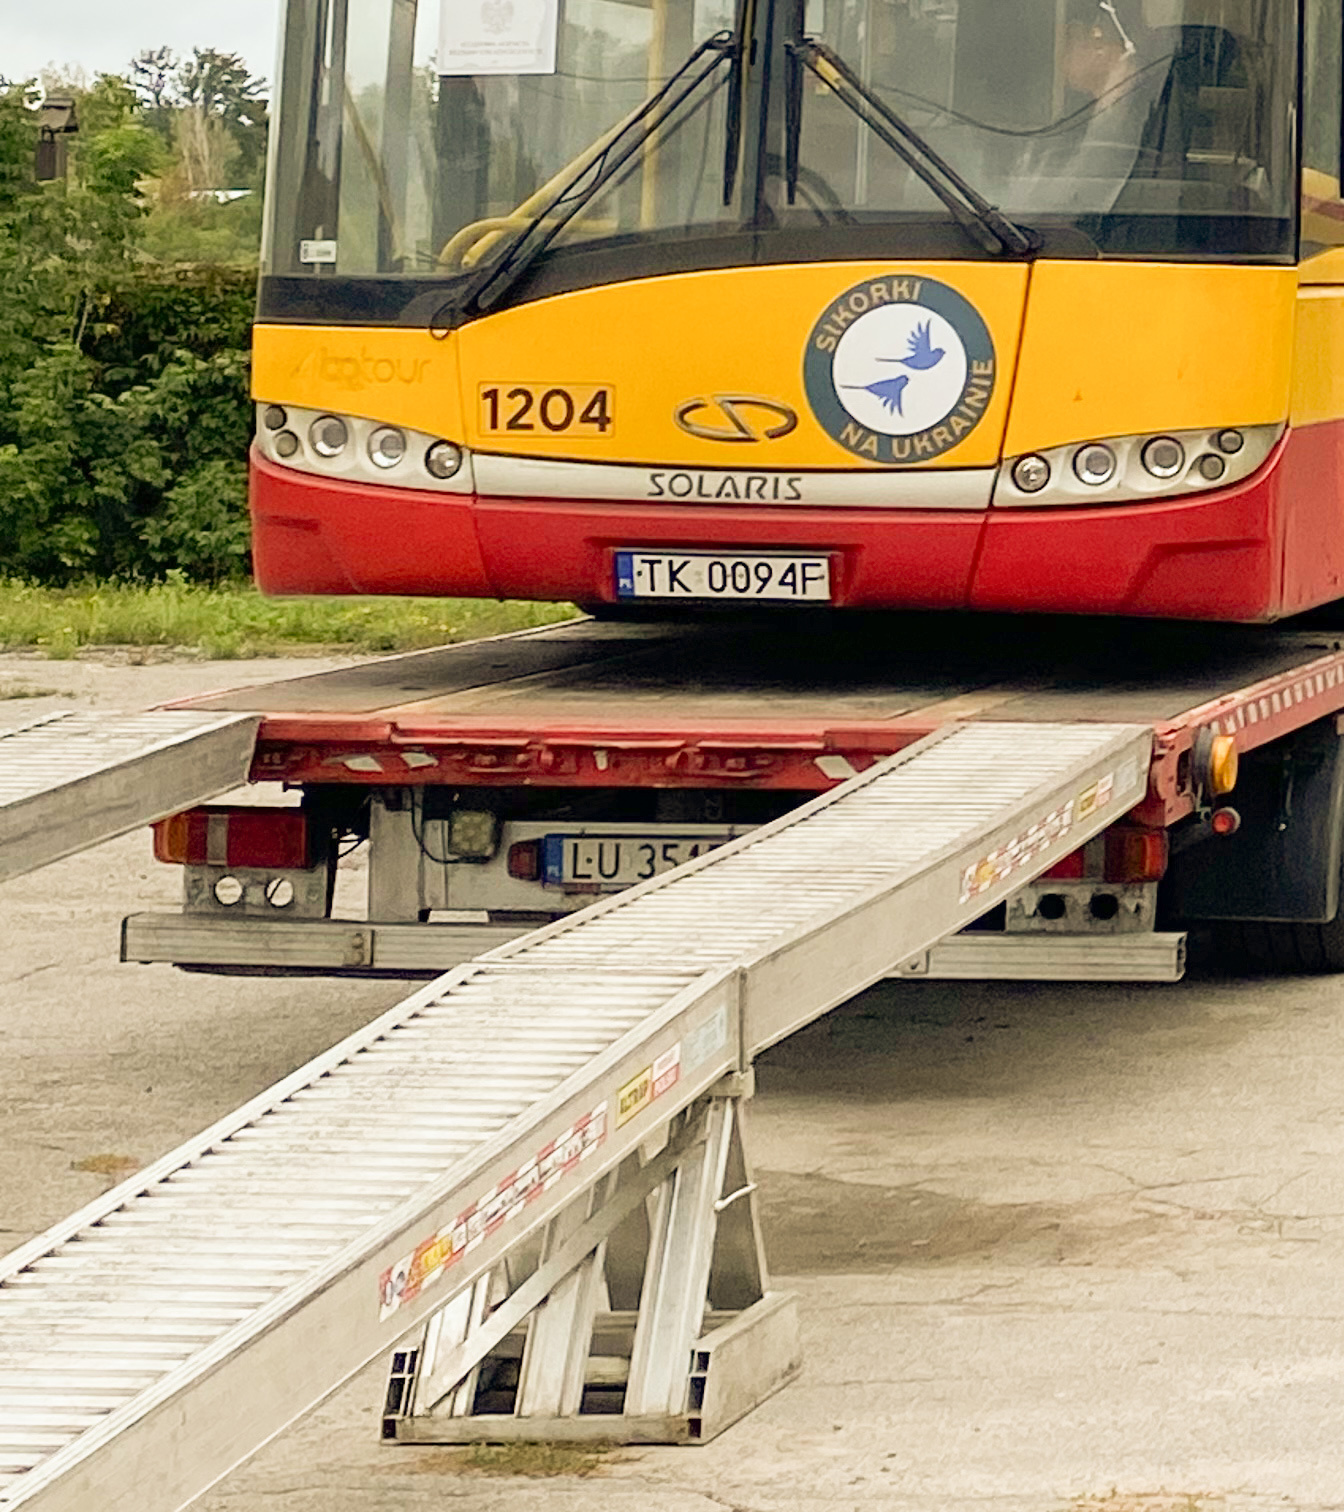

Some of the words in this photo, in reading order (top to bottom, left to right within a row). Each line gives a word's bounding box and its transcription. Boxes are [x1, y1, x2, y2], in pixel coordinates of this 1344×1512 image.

[815, 278, 924, 354] SIKORKI
[481, 387, 612, 433] 1204
[840, 422, 879, 457] NA
[891, 358, 994, 459] UKRAINIE
[646, 472, 803, 501] SOLARIS
[640, 559, 692, 593] TK
[708, 560, 823, 595] 0094F
[572, 843, 621, 879] LU
[637, 843, 725, 879] 35
